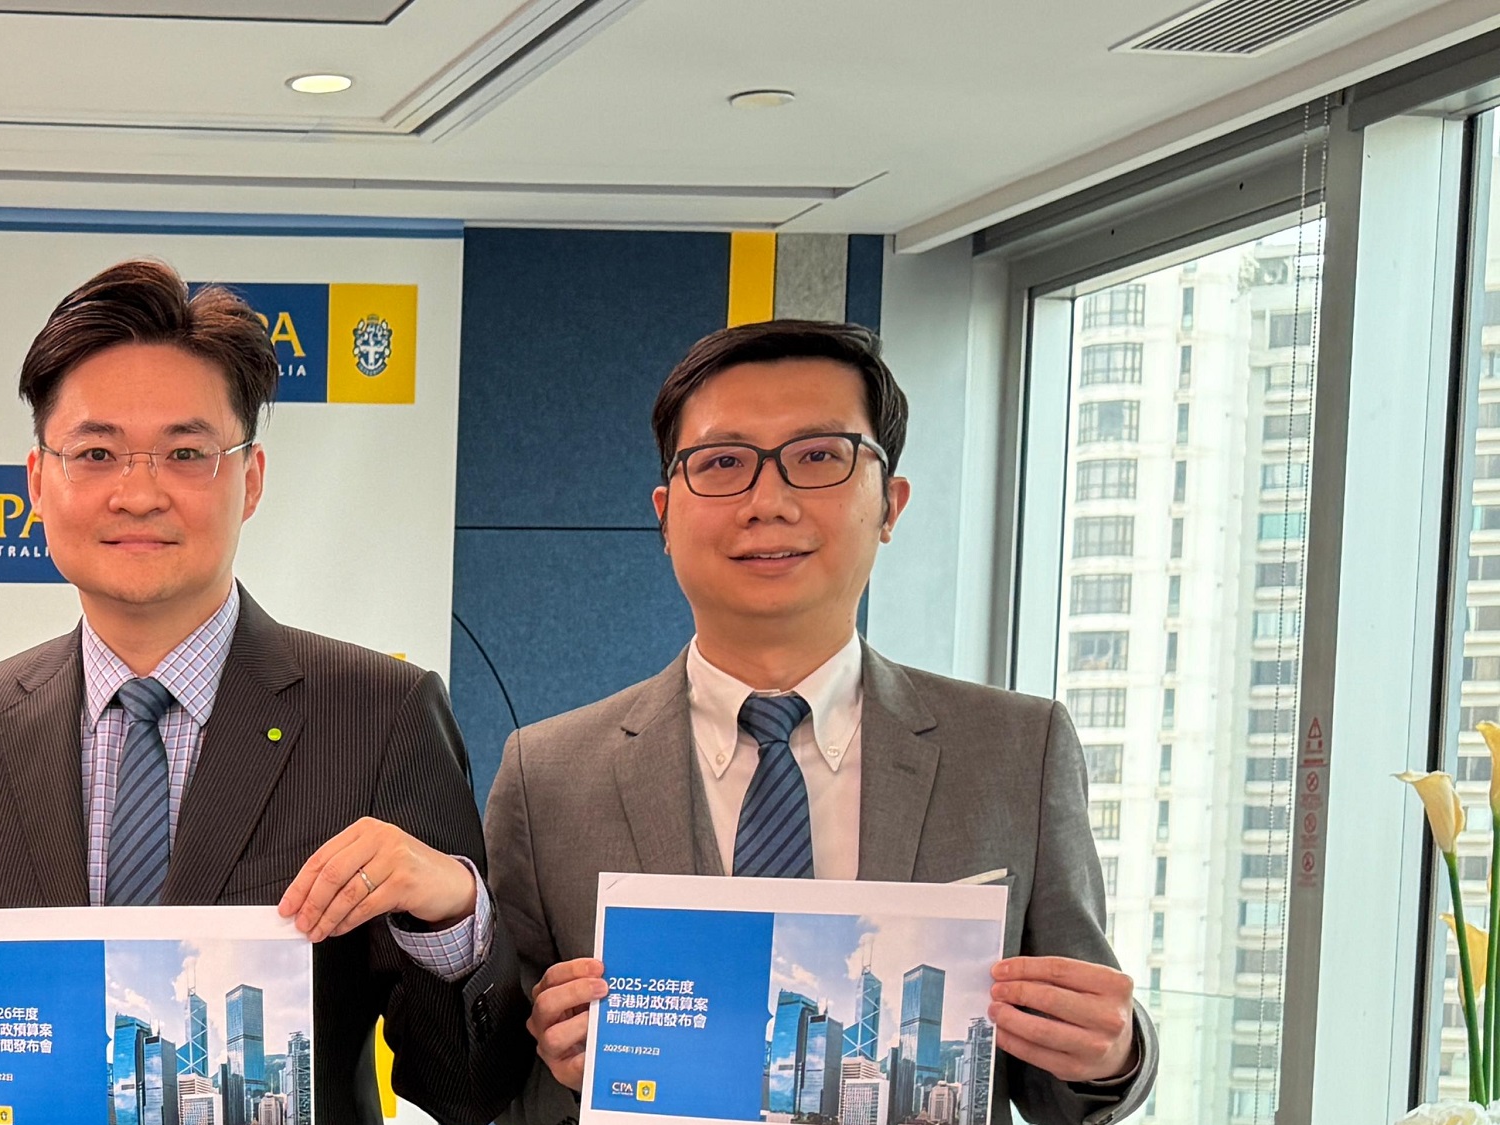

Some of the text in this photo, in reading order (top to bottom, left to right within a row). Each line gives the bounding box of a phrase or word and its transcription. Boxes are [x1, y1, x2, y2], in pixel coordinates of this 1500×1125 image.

[609, 977, 695, 995] 2025-26年度
[608, 994, 708, 1012] 香港財政預算案
